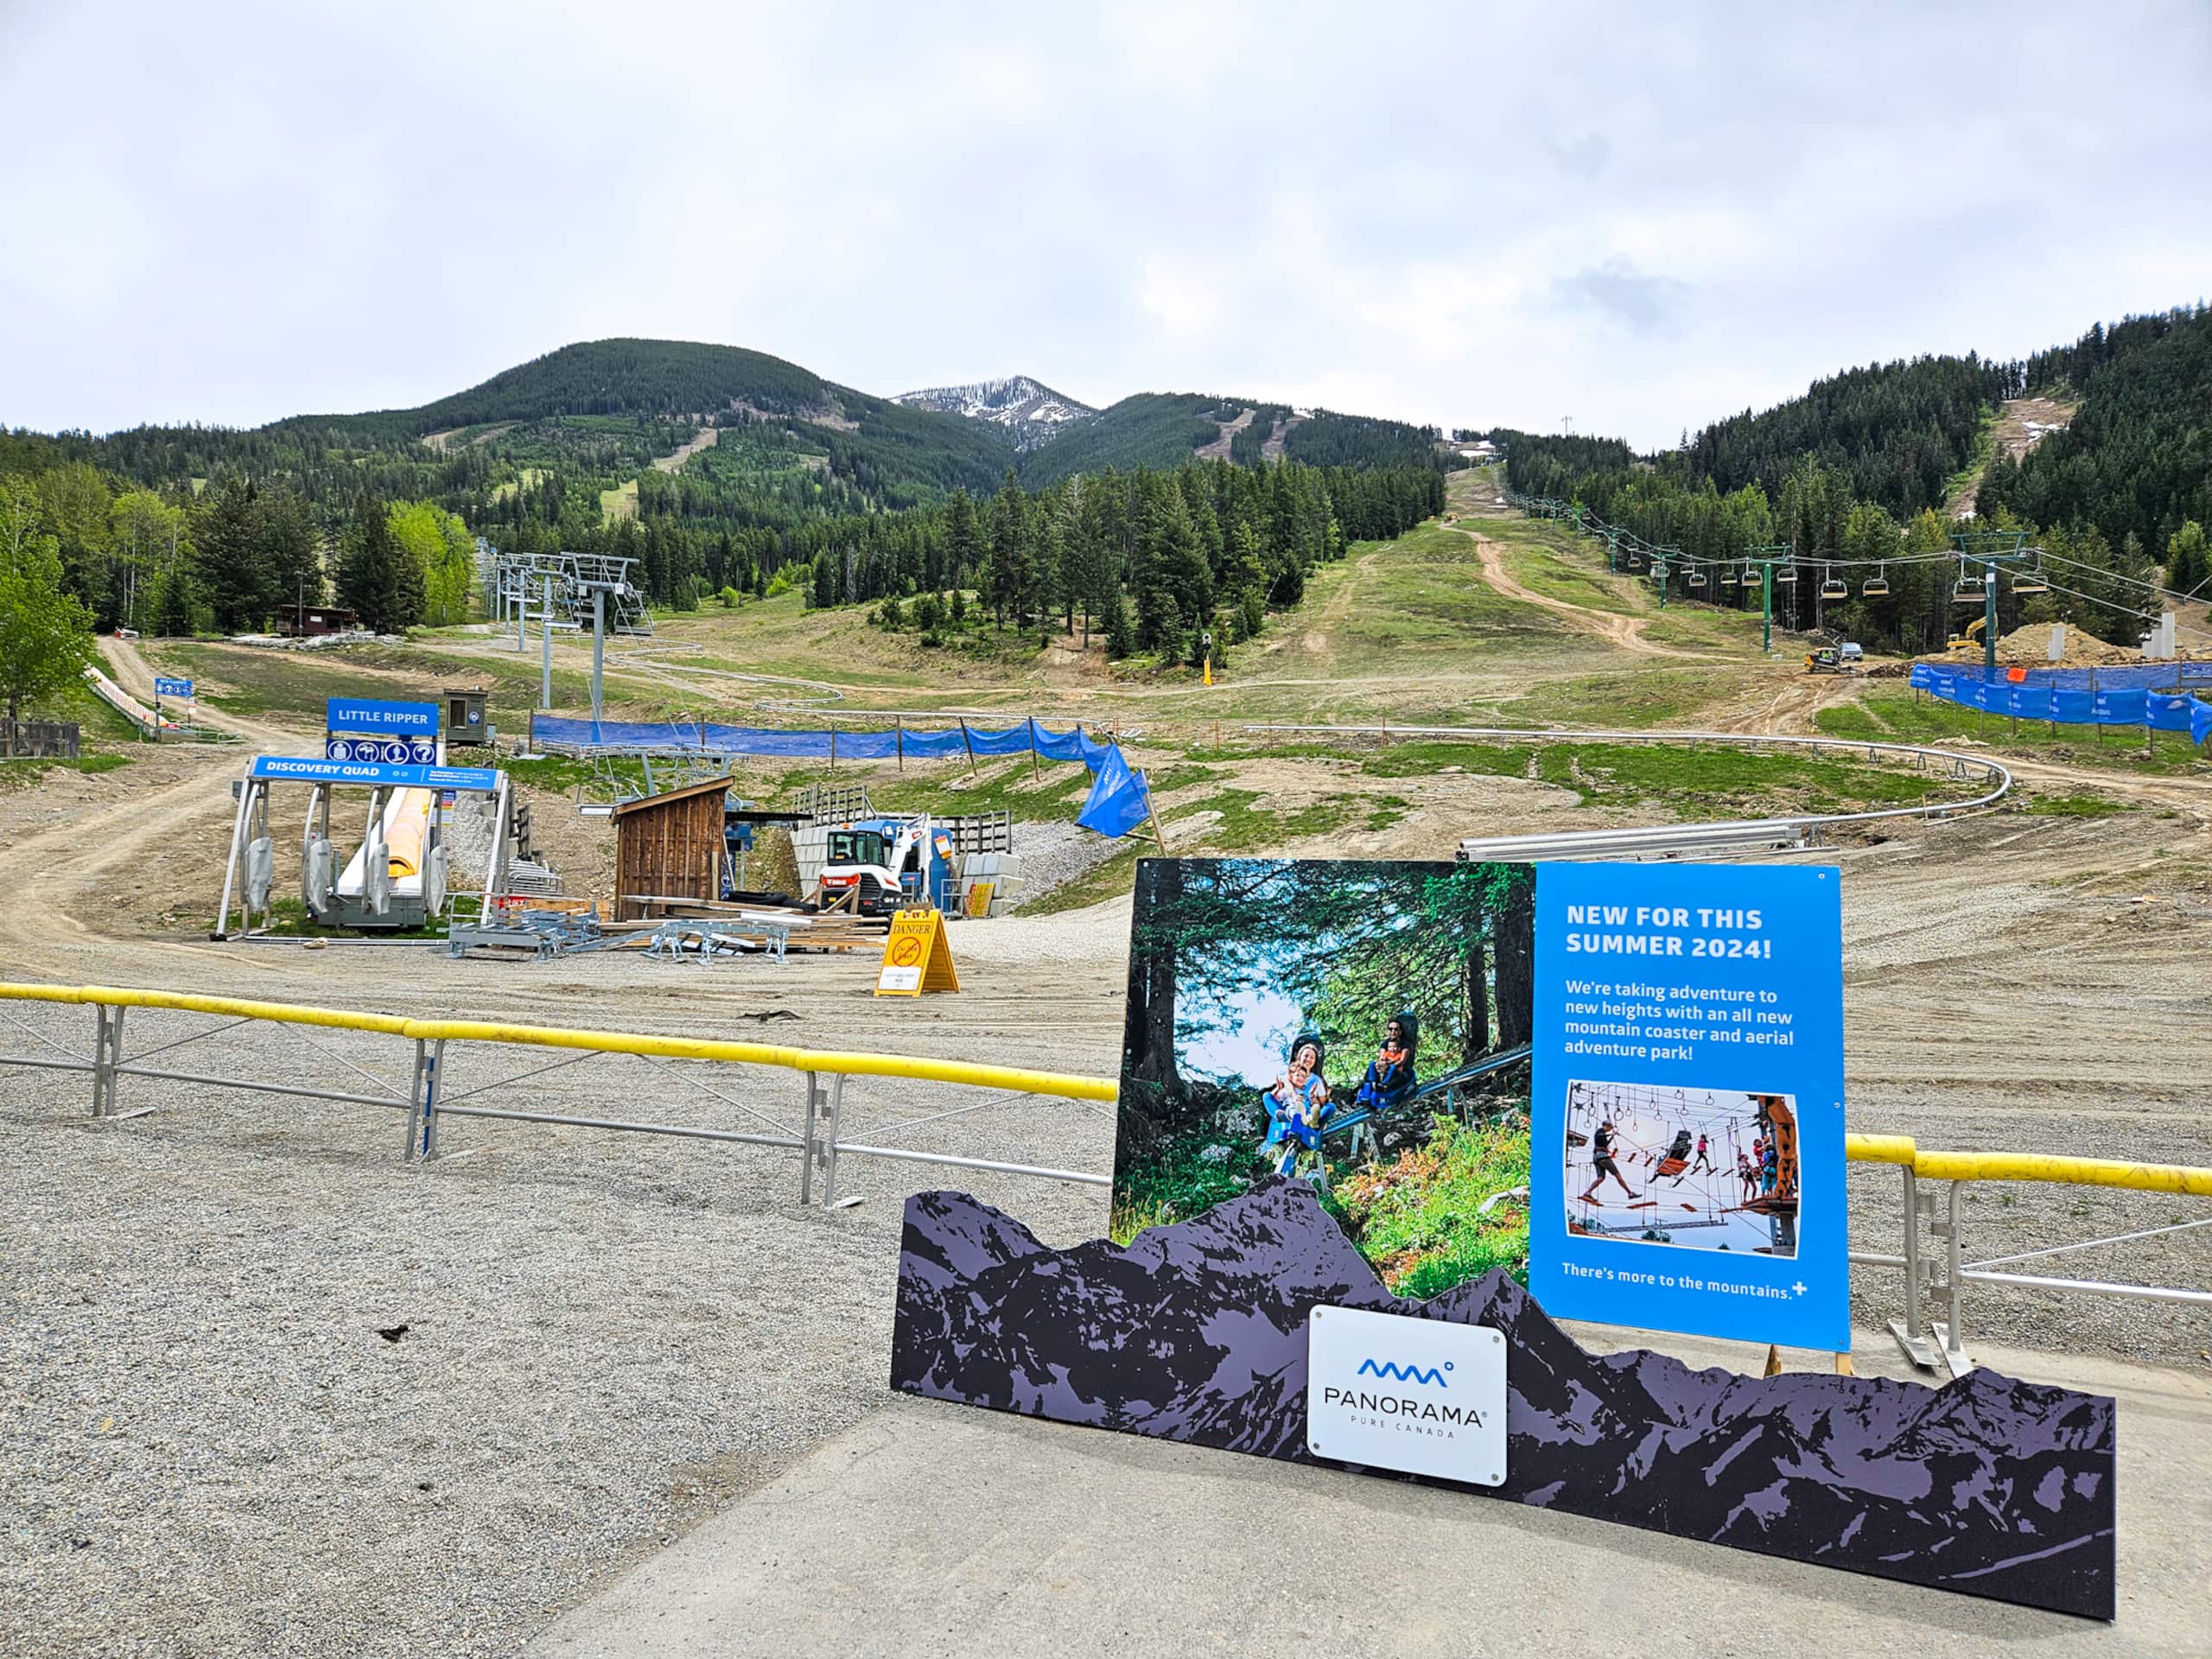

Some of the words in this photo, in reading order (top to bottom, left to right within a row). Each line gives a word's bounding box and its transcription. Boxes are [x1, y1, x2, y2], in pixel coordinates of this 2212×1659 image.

[339, 709, 381, 721] LITTLE
[384, 712, 429, 724] RIPPER
[266, 761, 340, 775] DISCOVERY
[342, 766, 380, 777] QUAD
[893, 925, 931, 934] DANGER
[1567, 905, 1628, 925] NEW
[1637, 907, 1689, 928] FOR
[1696, 908, 1763, 930] THIS
[1566, 933, 1684, 957] SUMMER
[1691, 938, 1772, 959] 2024!
[1566, 980, 1611, 995] We're
[1615, 982, 1666, 1002] taking
[1669, 985, 1755, 1003] adventure
[1759, 988, 1777, 1003] to
[1565, 1002, 1599, 1015] new
[1602, 1000, 1662, 1020] heights
[1666, 1004, 1703, 1020] with
[1707, 1009, 1727, 1021] an
[1732, 1007, 1752, 1023] all
[1757, 1012, 1792, 1026] new
[1565, 1020, 1641, 1037] mountain
[1644, 1025, 1707, 1040] coaster
[1709, 1027, 1741, 1043] and
[1745, 1030, 1795, 1046] aerial
[1564, 1039, 1647, 1058] adventure
[1650, 1045, 1694, 1062] park!
[1561, 1262, 1615, 1281] There's
[1618, 1271, 1656, 1285] more
[1659, 1273, 1675, 1287] to
[1678, 1274, 1703, 1290] the
[1351, 1415, 1386, 1428] PURE
[1396, 1422, 1454, 1439] CANADA
